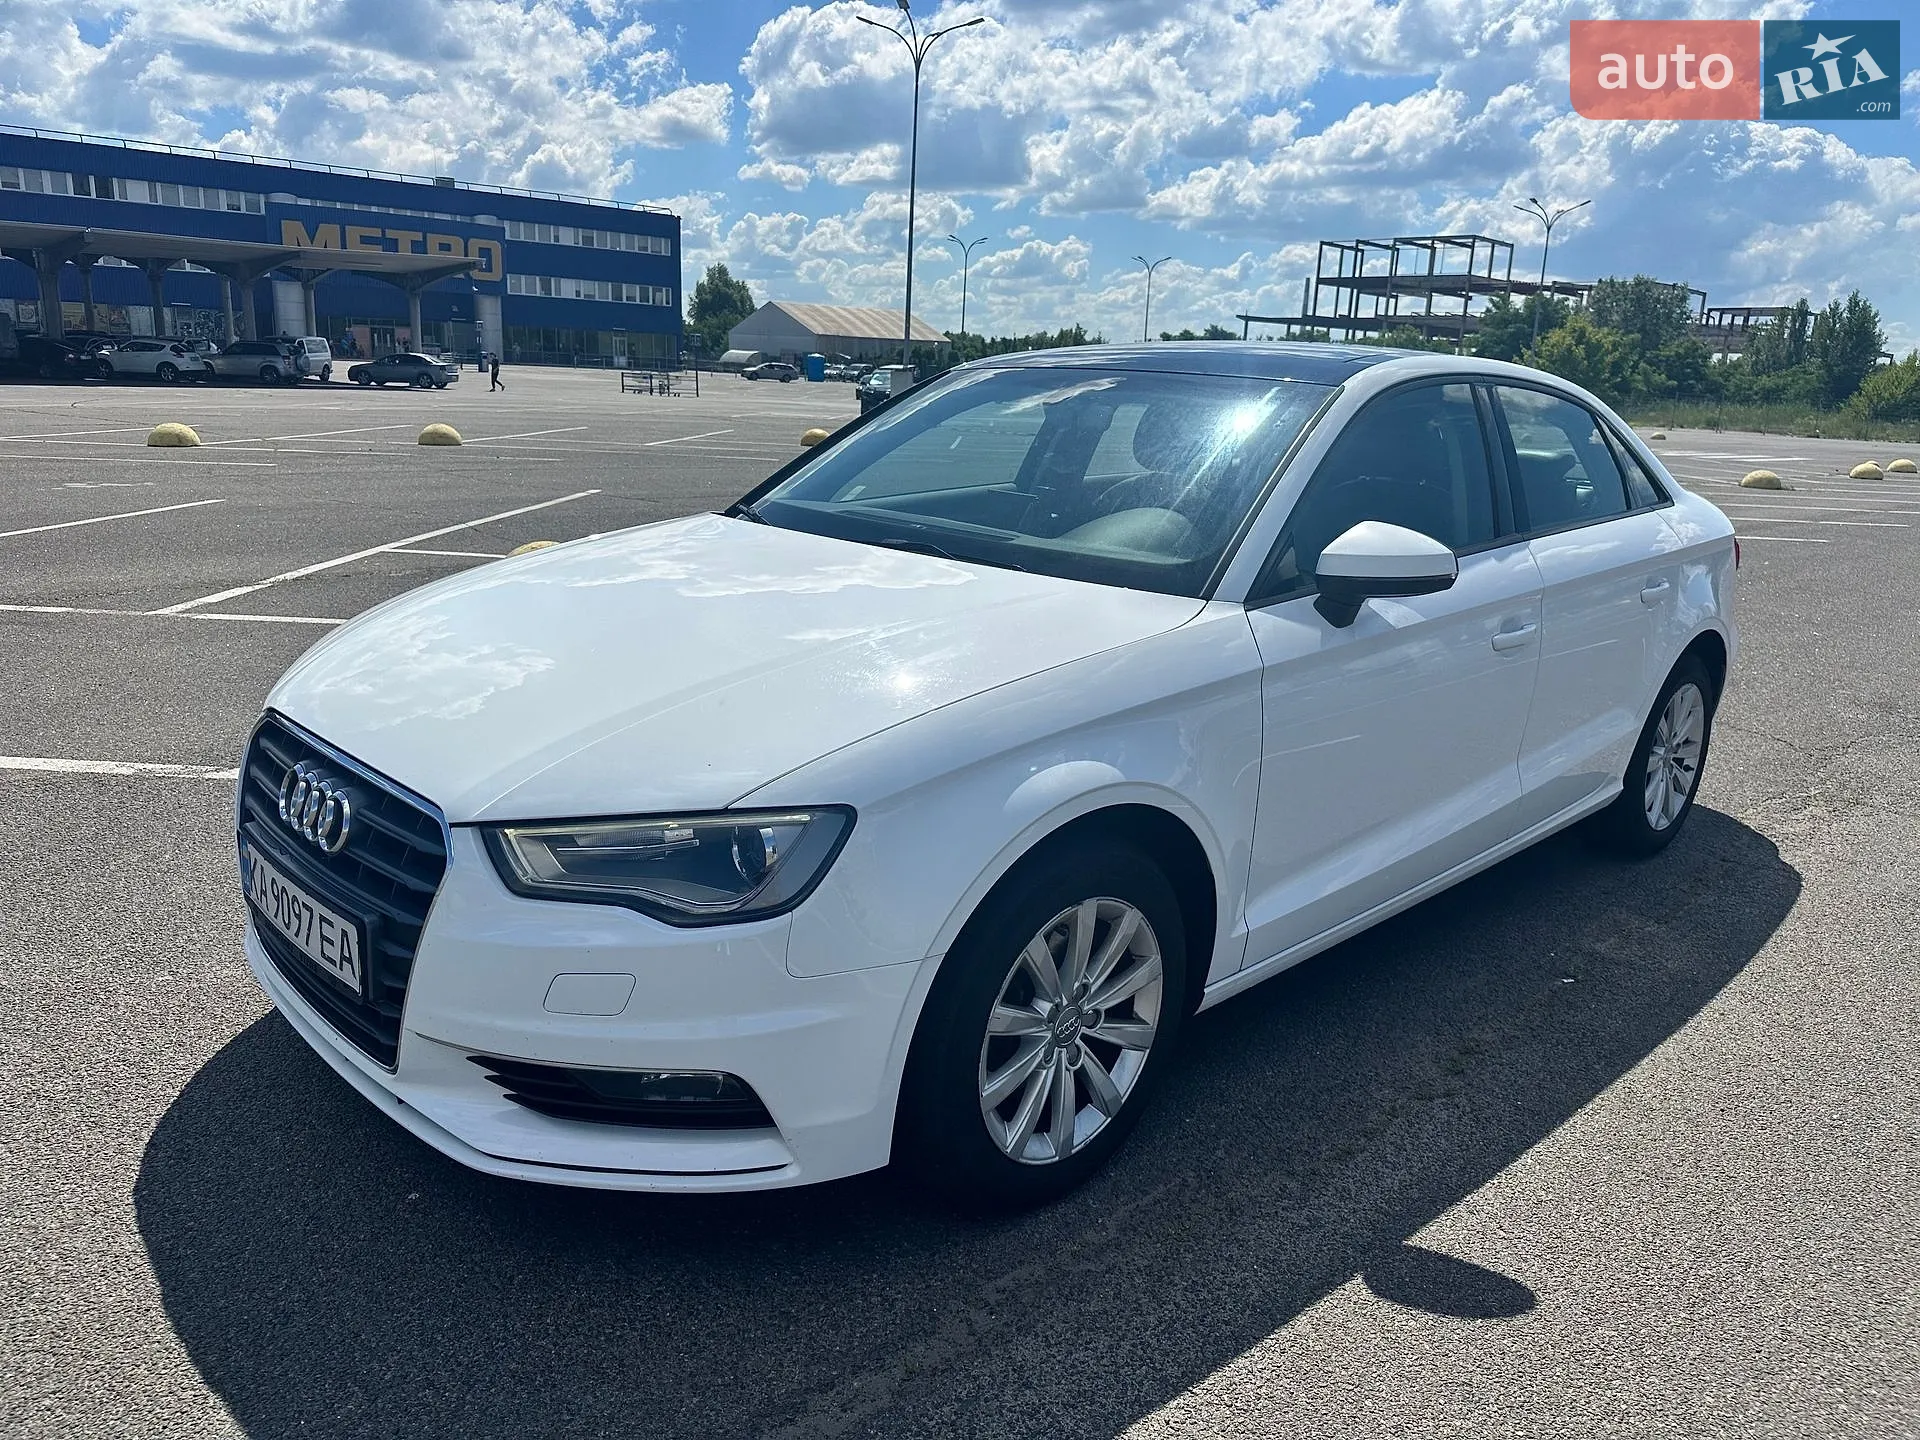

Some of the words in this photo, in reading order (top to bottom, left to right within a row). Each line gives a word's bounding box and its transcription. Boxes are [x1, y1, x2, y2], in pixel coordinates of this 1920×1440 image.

[249, 849, 269, 912] KA
[270, 877, 314, 947] 9097
[318, 913, 359, 981] EA
